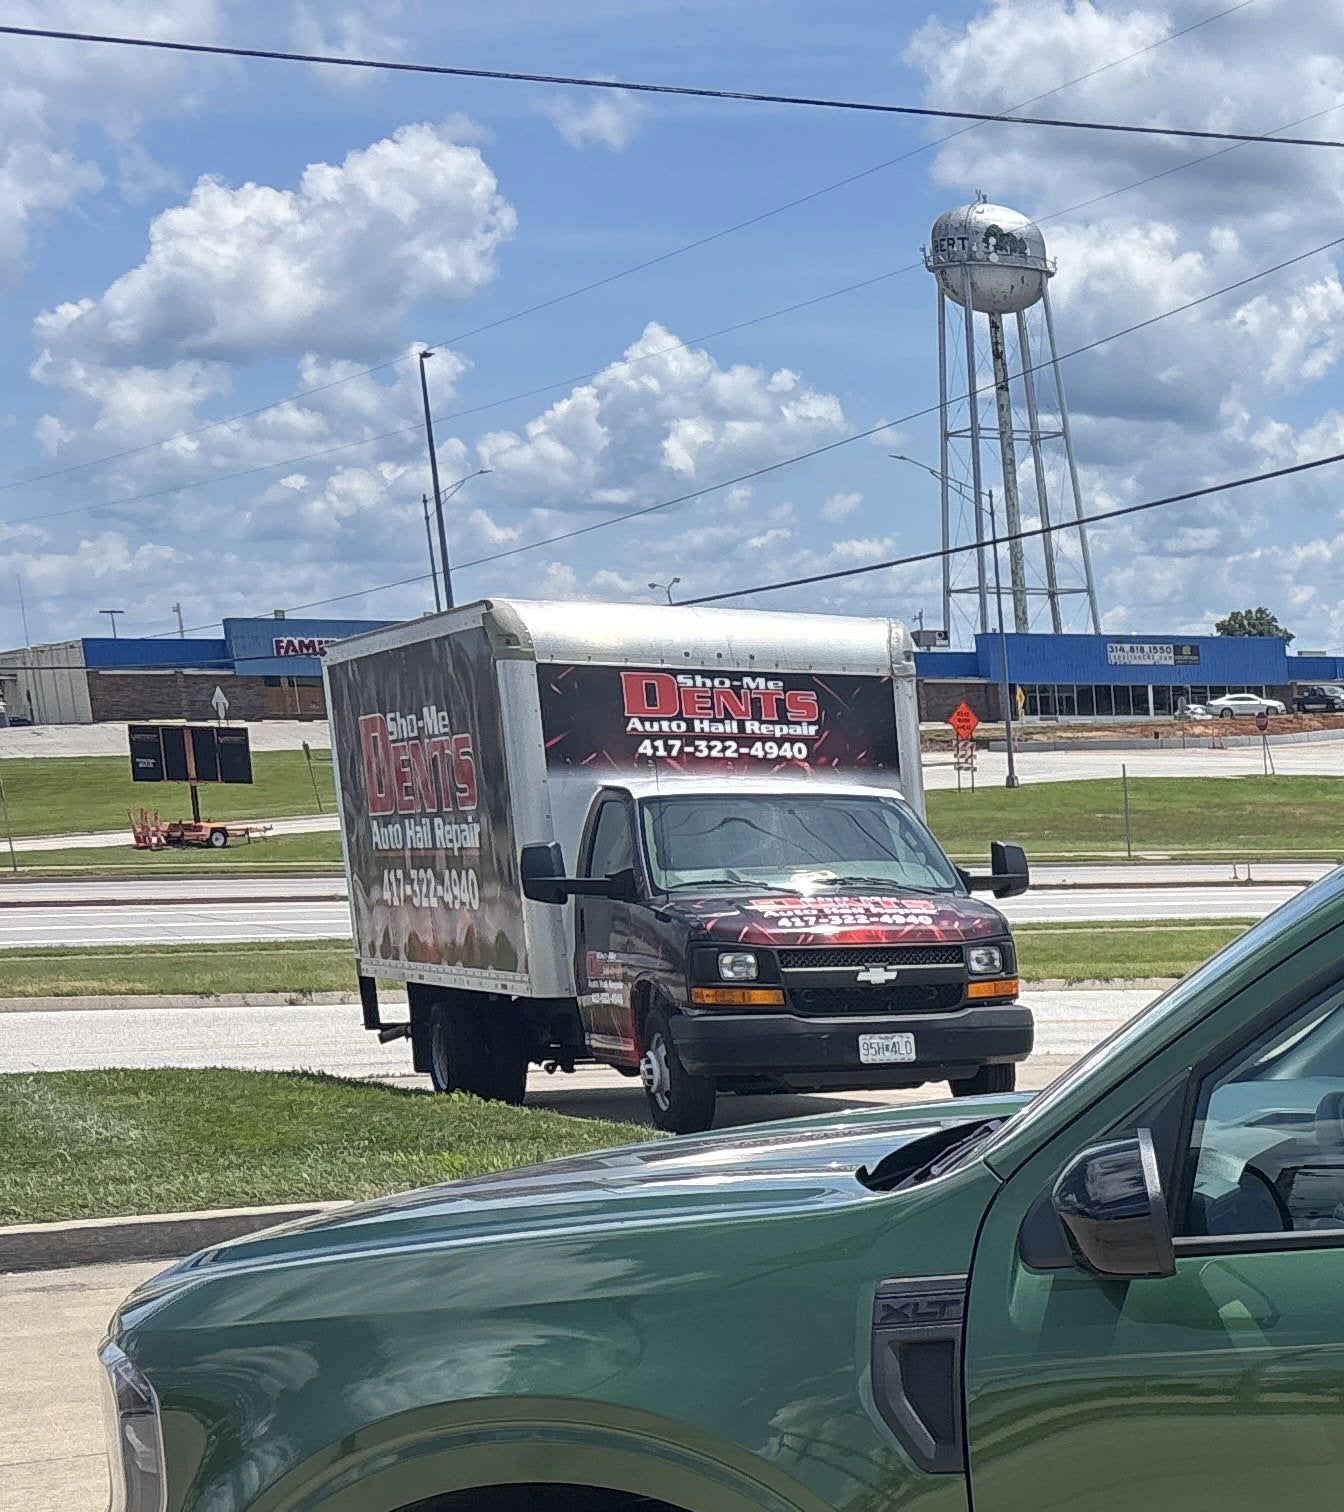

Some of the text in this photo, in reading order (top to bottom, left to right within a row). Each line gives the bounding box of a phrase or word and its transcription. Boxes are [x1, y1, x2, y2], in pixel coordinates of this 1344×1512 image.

[620, 671, 820, 721] DENTS
[676, 674, 784, 690] Sho-Me
[386, 705, 450, 740] Sho-Me
[626, 717, 819, 737] Auto Hail Repair
[358, 712, 478, 816] DENTS
[637, 738, 808, 760] 417-322-4940
[372, 815, 481, 856] Auto Hail Repair
[382, 867, 480, 910] 417-322-4940
[879, 1298, 961, 1323] XLT
